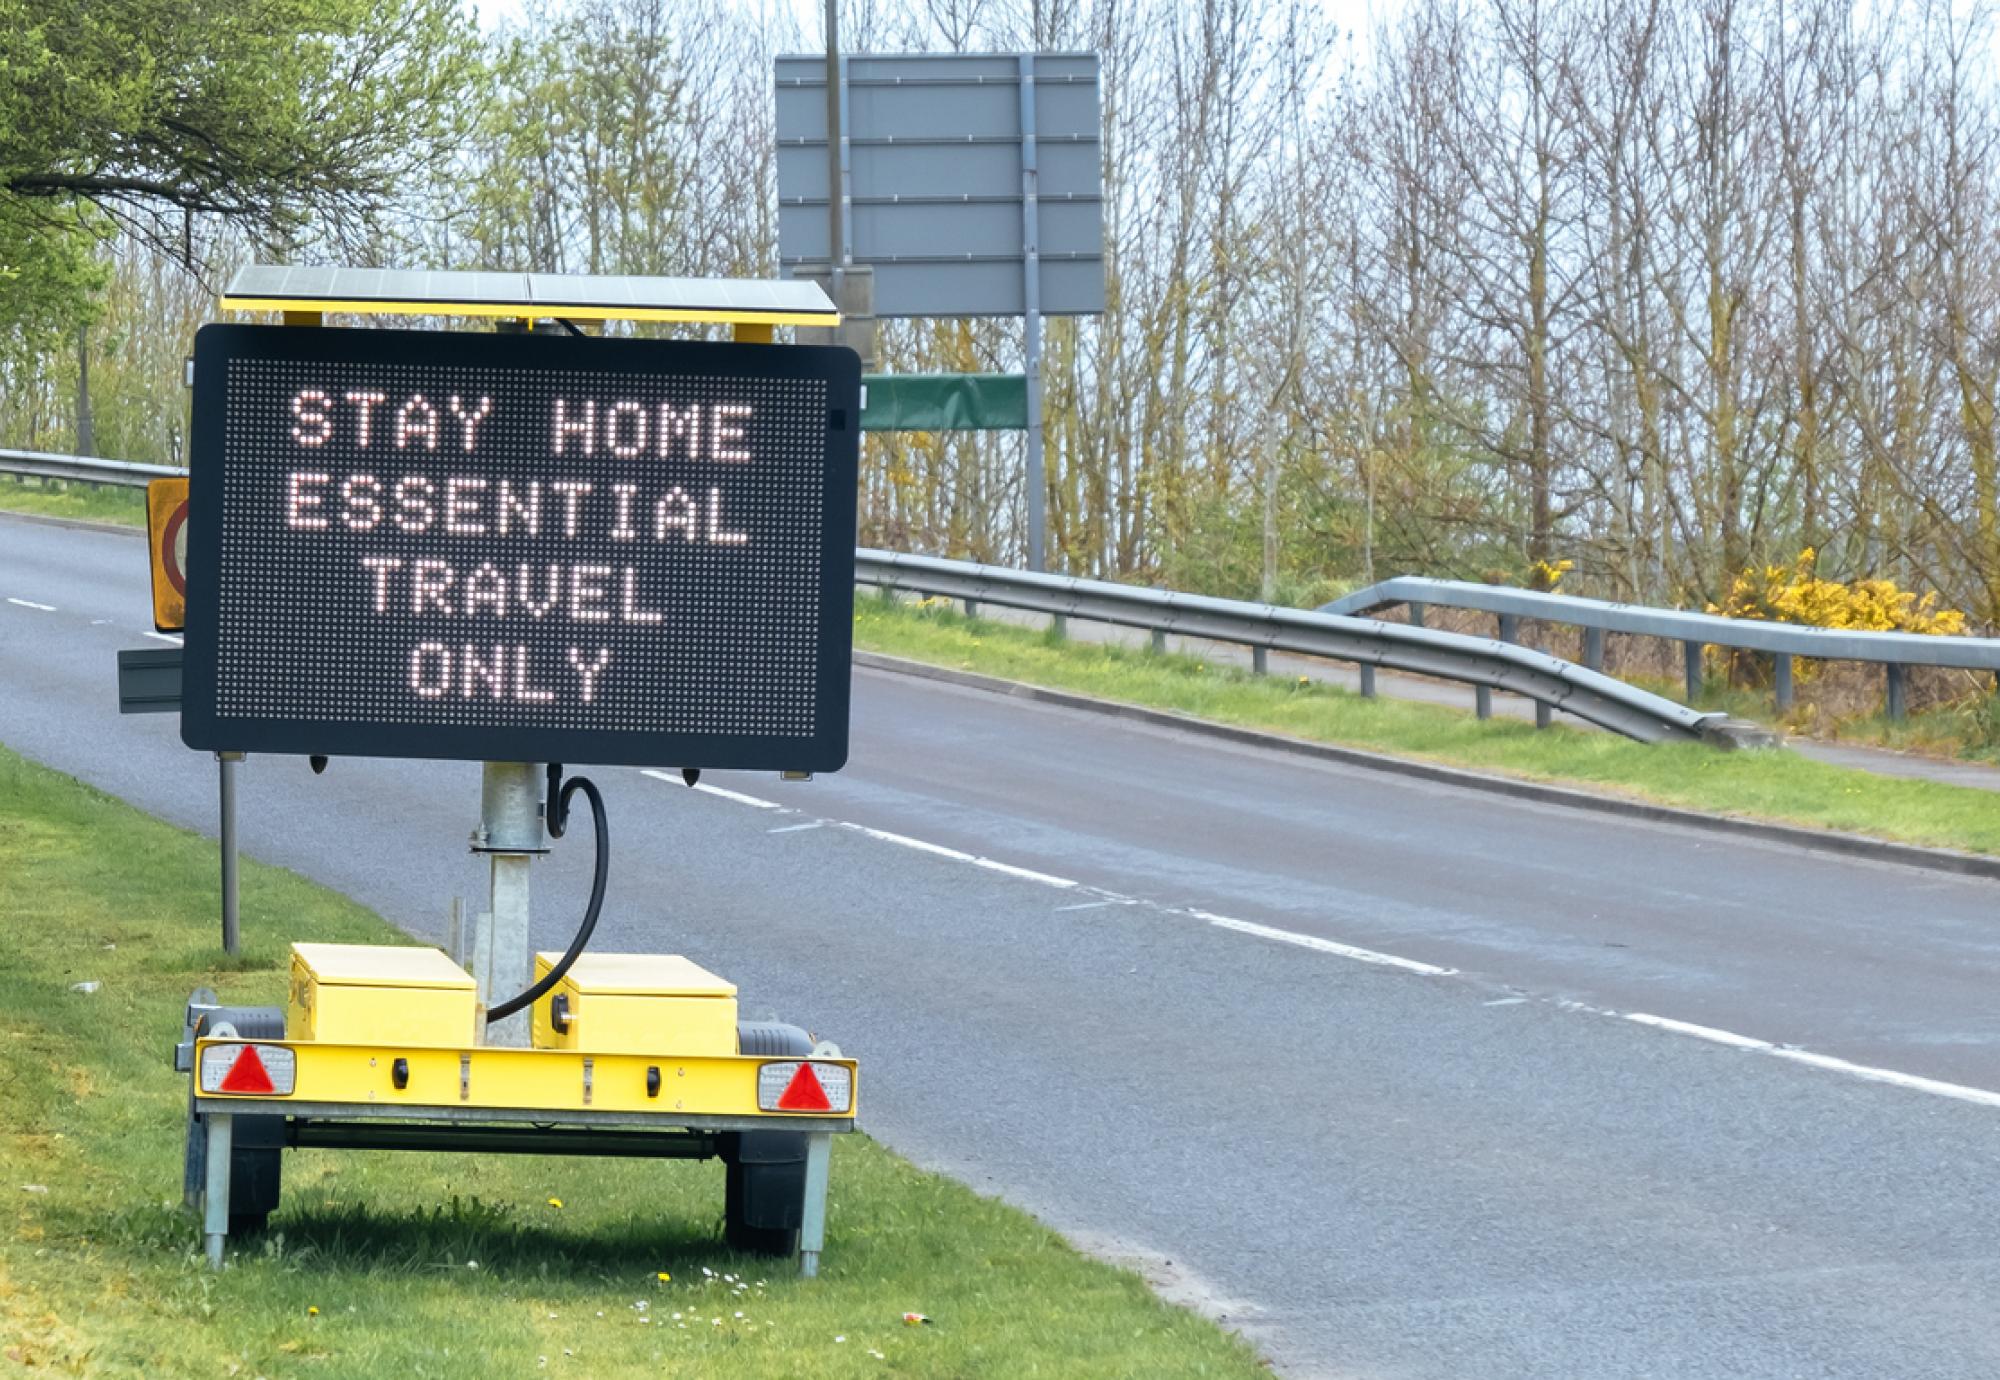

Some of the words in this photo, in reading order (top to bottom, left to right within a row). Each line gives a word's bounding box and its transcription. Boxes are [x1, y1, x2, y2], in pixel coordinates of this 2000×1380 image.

[292, 389, 493, 451] STAY
[553, 397, 754, 462] HOME
[287, 473, 749, 544] ESSENTIAL
[363, 557, 663, 624] TRAVEL
[409, 642, 610, 701] ONLY
